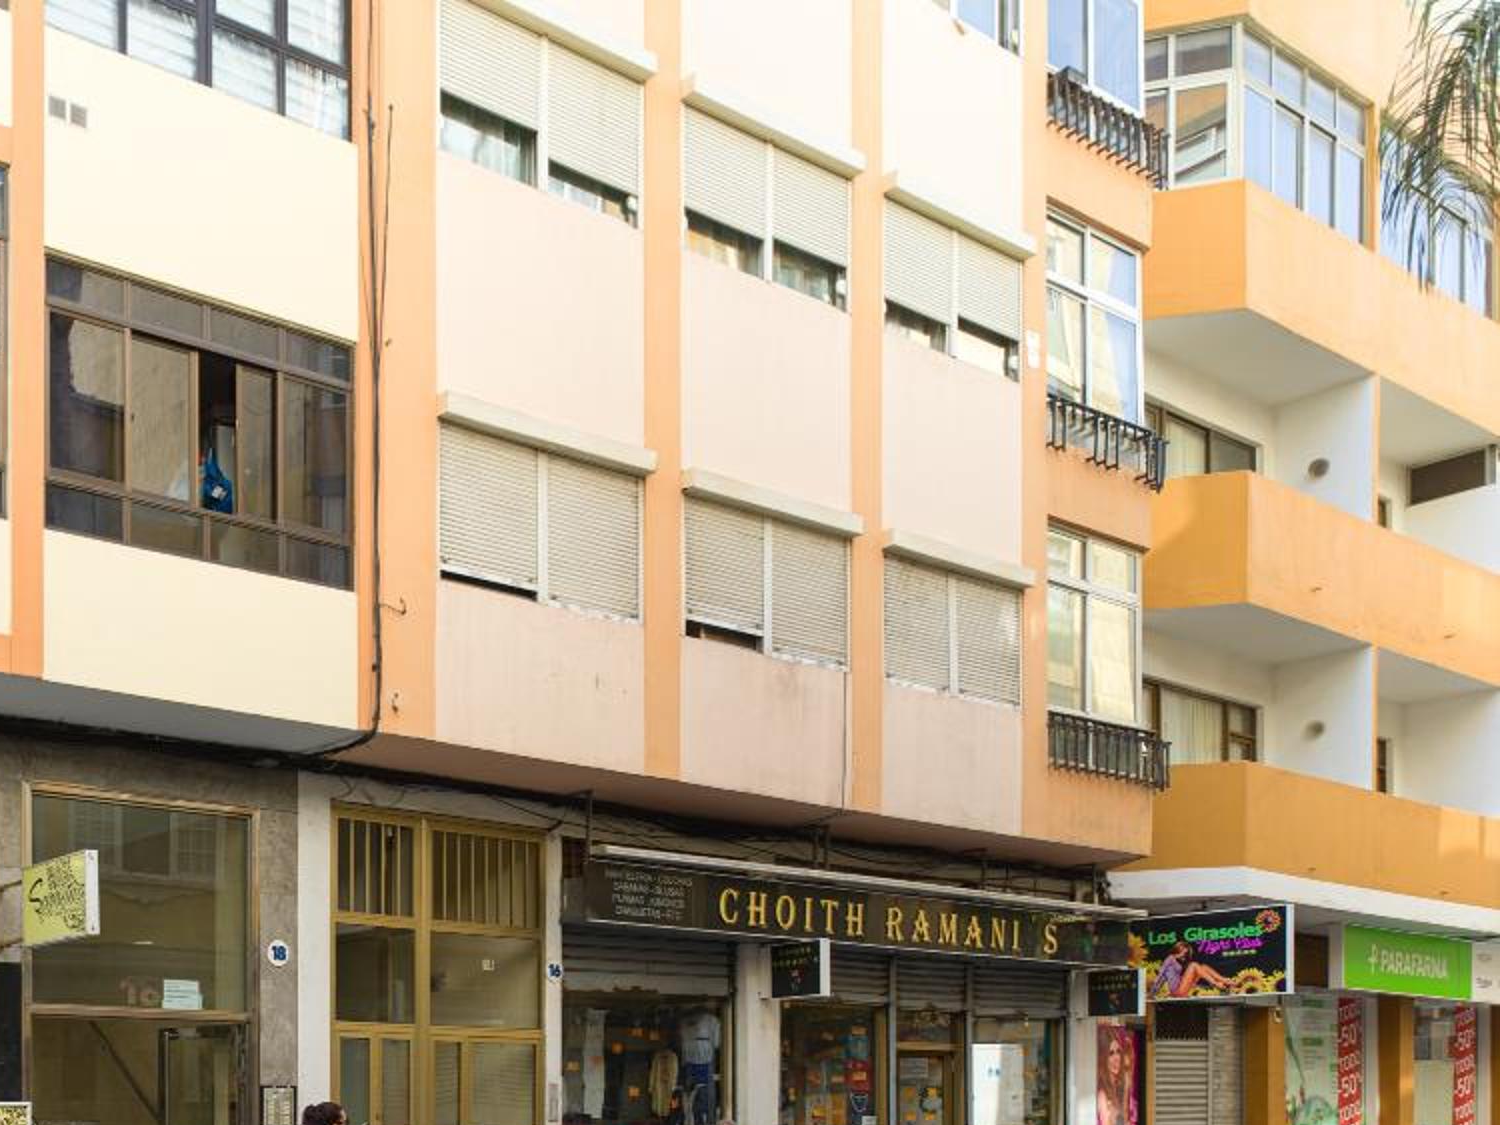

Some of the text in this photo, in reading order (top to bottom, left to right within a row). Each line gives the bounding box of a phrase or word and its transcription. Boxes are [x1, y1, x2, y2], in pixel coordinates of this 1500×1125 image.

[719, 887, 865, 937] CHOITH
[1148, 921, 1264, 946] Los Girasoles
[271, 945, 287, 961] 18
